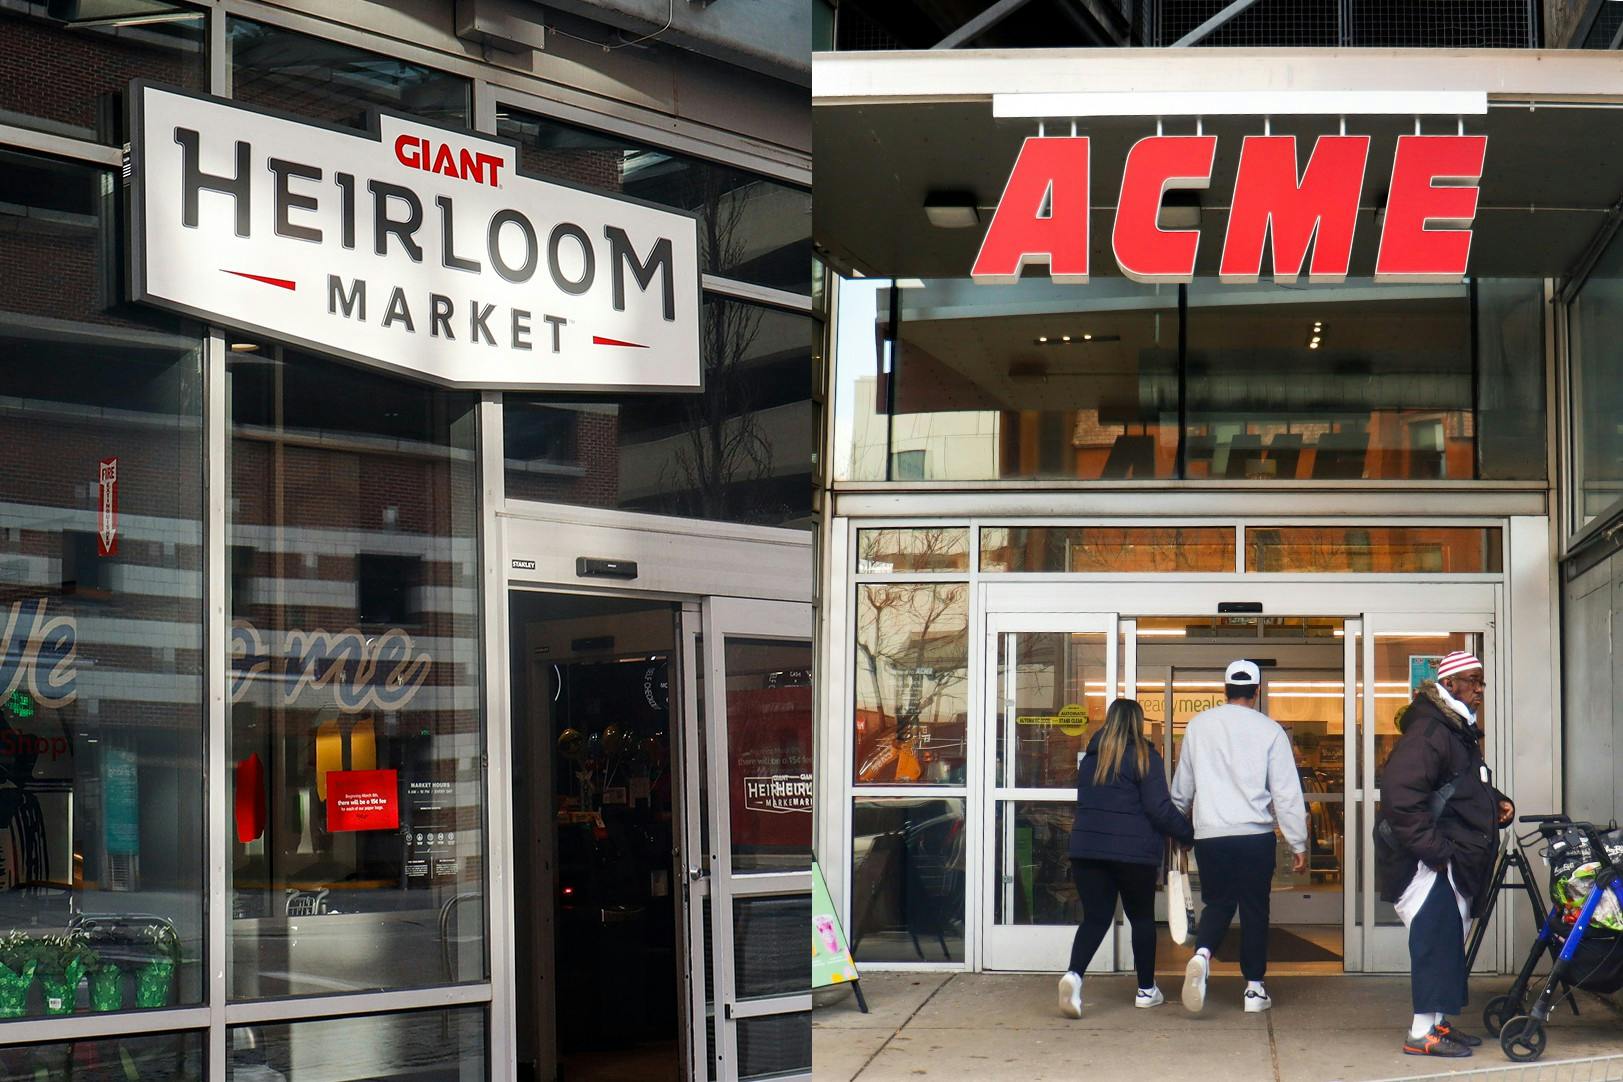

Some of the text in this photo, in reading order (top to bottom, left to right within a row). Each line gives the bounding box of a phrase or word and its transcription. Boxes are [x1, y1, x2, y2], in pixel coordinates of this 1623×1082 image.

[394, 134, 504, 188] GIANT
[174, 126, 676, 322] HEIRLOOM
[971, 135, 1488, 283] ACME
[327, 274, 568, 353] MARKET
[102, 466, 115, 481] FIRE
[512, 561, 535, 569] STANLEY
